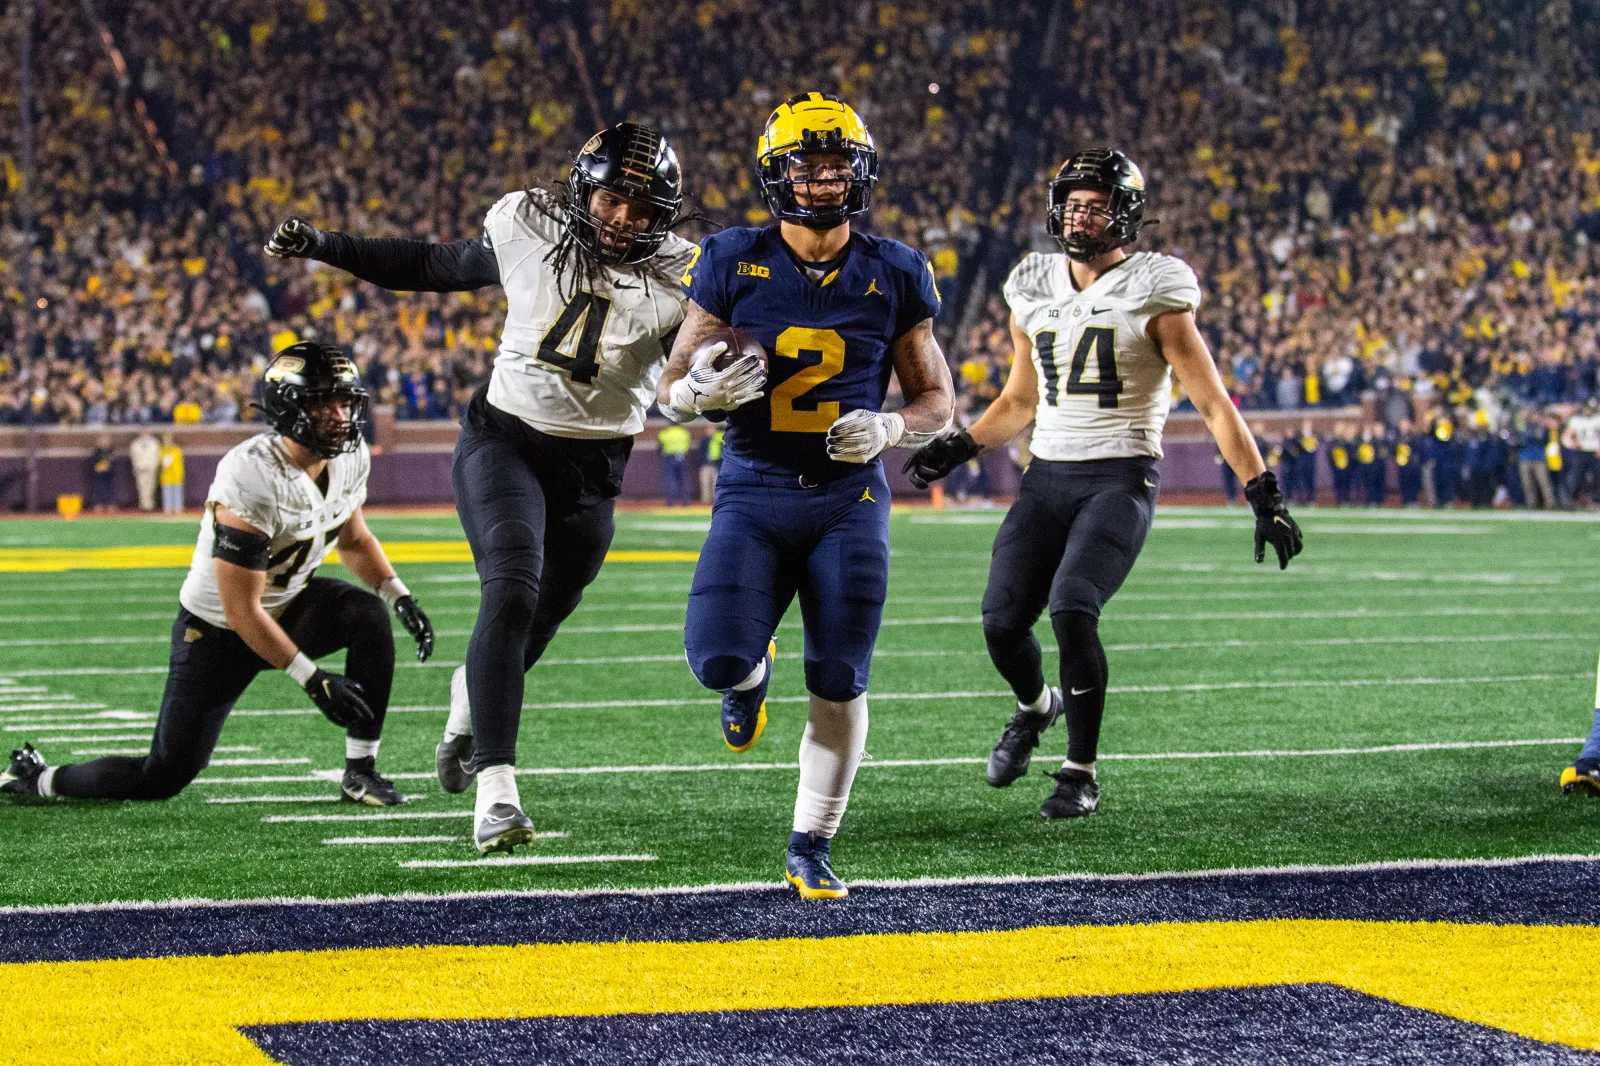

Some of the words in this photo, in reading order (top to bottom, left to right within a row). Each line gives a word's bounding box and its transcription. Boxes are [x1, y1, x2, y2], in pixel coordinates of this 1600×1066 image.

[816, 131, 827, 139] M
[534, 289, 615, 386] 4
[770, 326, 846, 433] 2
[1033, 325, 1124, 409] 14
[730, 723, 741, 733] M
